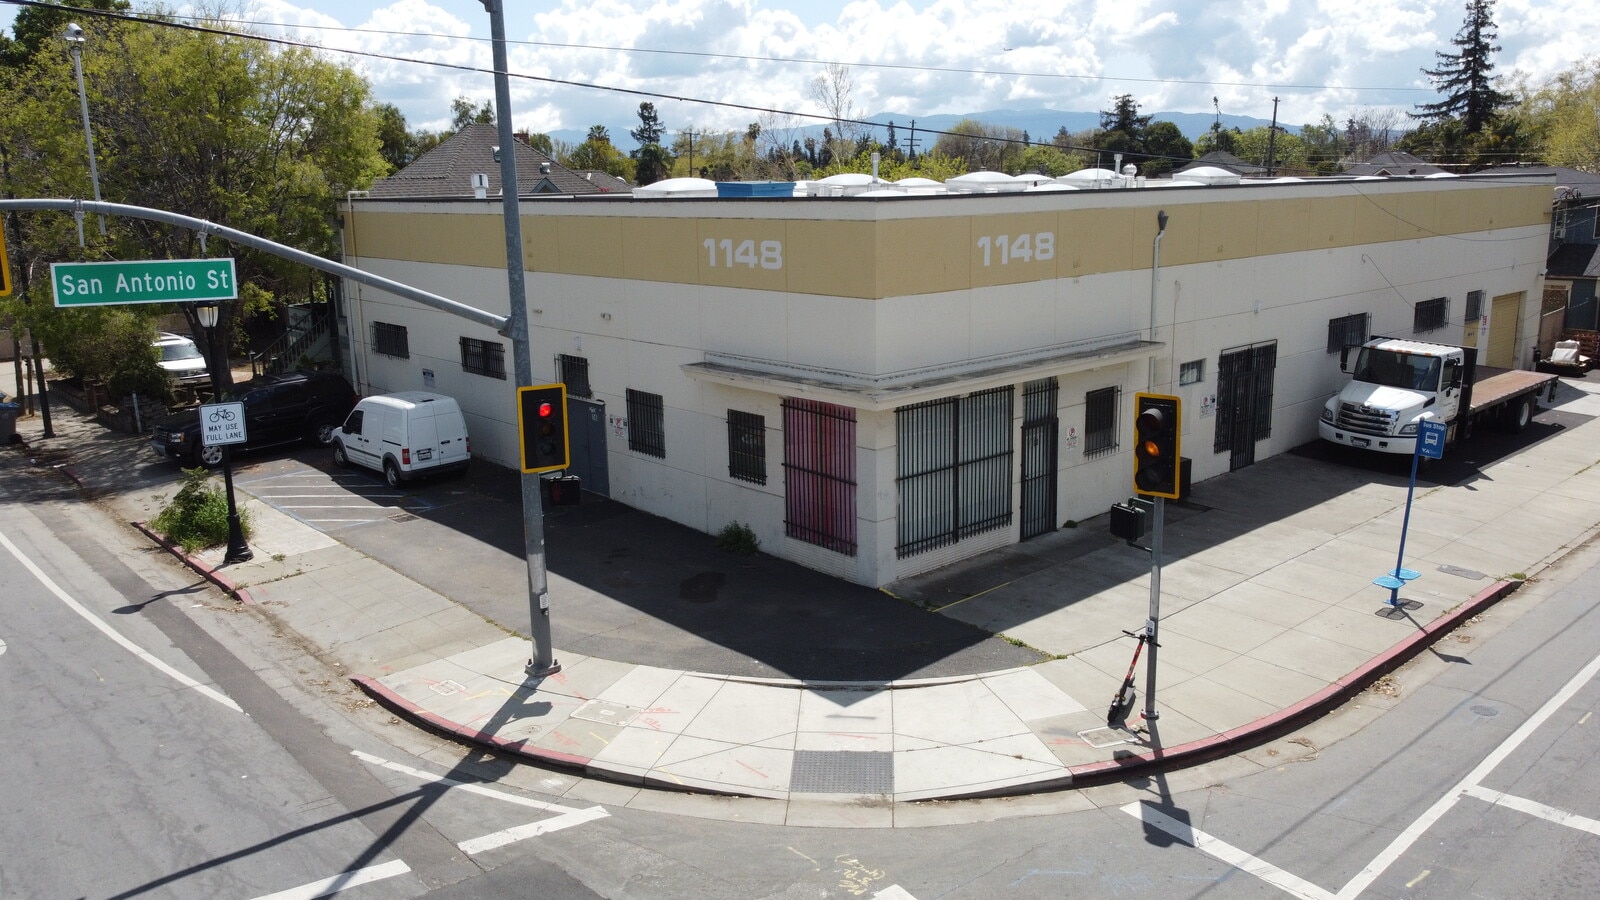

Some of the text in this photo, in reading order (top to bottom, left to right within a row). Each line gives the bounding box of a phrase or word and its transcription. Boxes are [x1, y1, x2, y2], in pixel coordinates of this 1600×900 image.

[703, 238, 783, 270] 1148
[977, 231, 1055, 267] 1148
[61, 269, 229, 296] San Antonio St
[206, 431, 243, 441] FULL LANE
[208, 424, 222, 432] MAY
